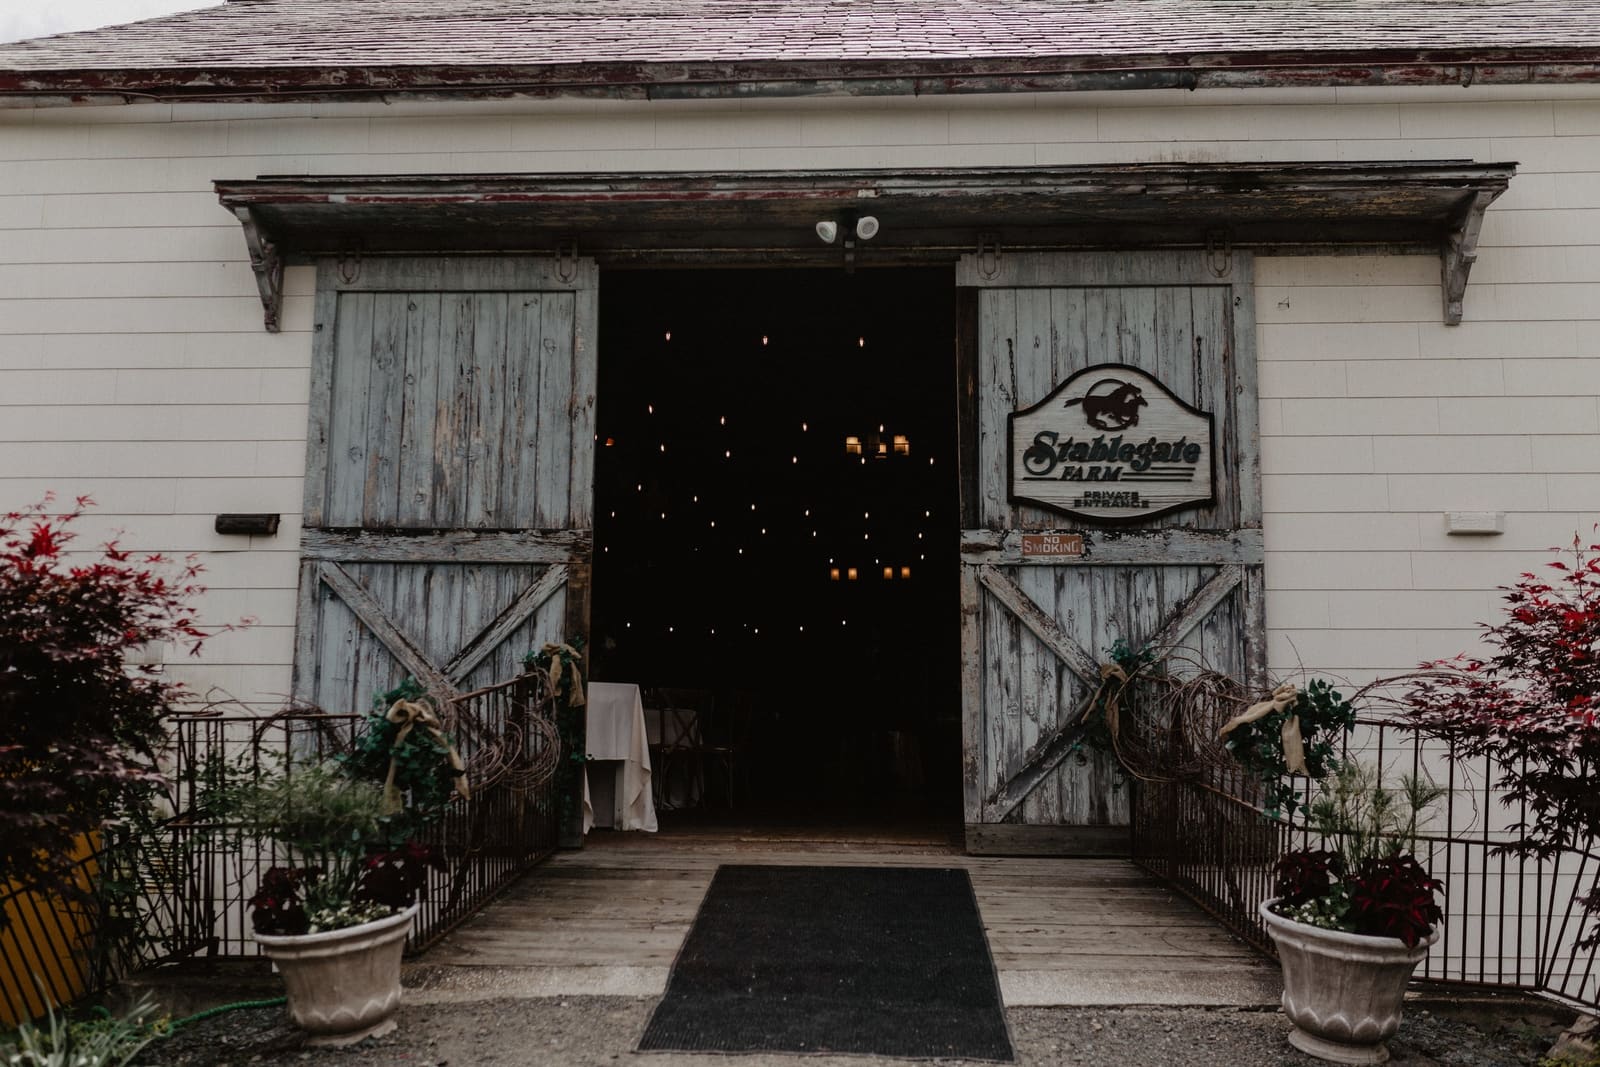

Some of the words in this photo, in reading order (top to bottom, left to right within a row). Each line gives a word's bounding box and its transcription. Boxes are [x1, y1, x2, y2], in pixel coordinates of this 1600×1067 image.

[1023, 431, 1200, 476] Stablegate
[1059, 466, 1123, 481] FARM
[1084, 491, 1139, 500] PRIVATE
[1074, 499, 1150, 508] ENTRANCE
[1043, 536, 1060, 544] NO
[1023, 540, 1080, 553] SMOKING
